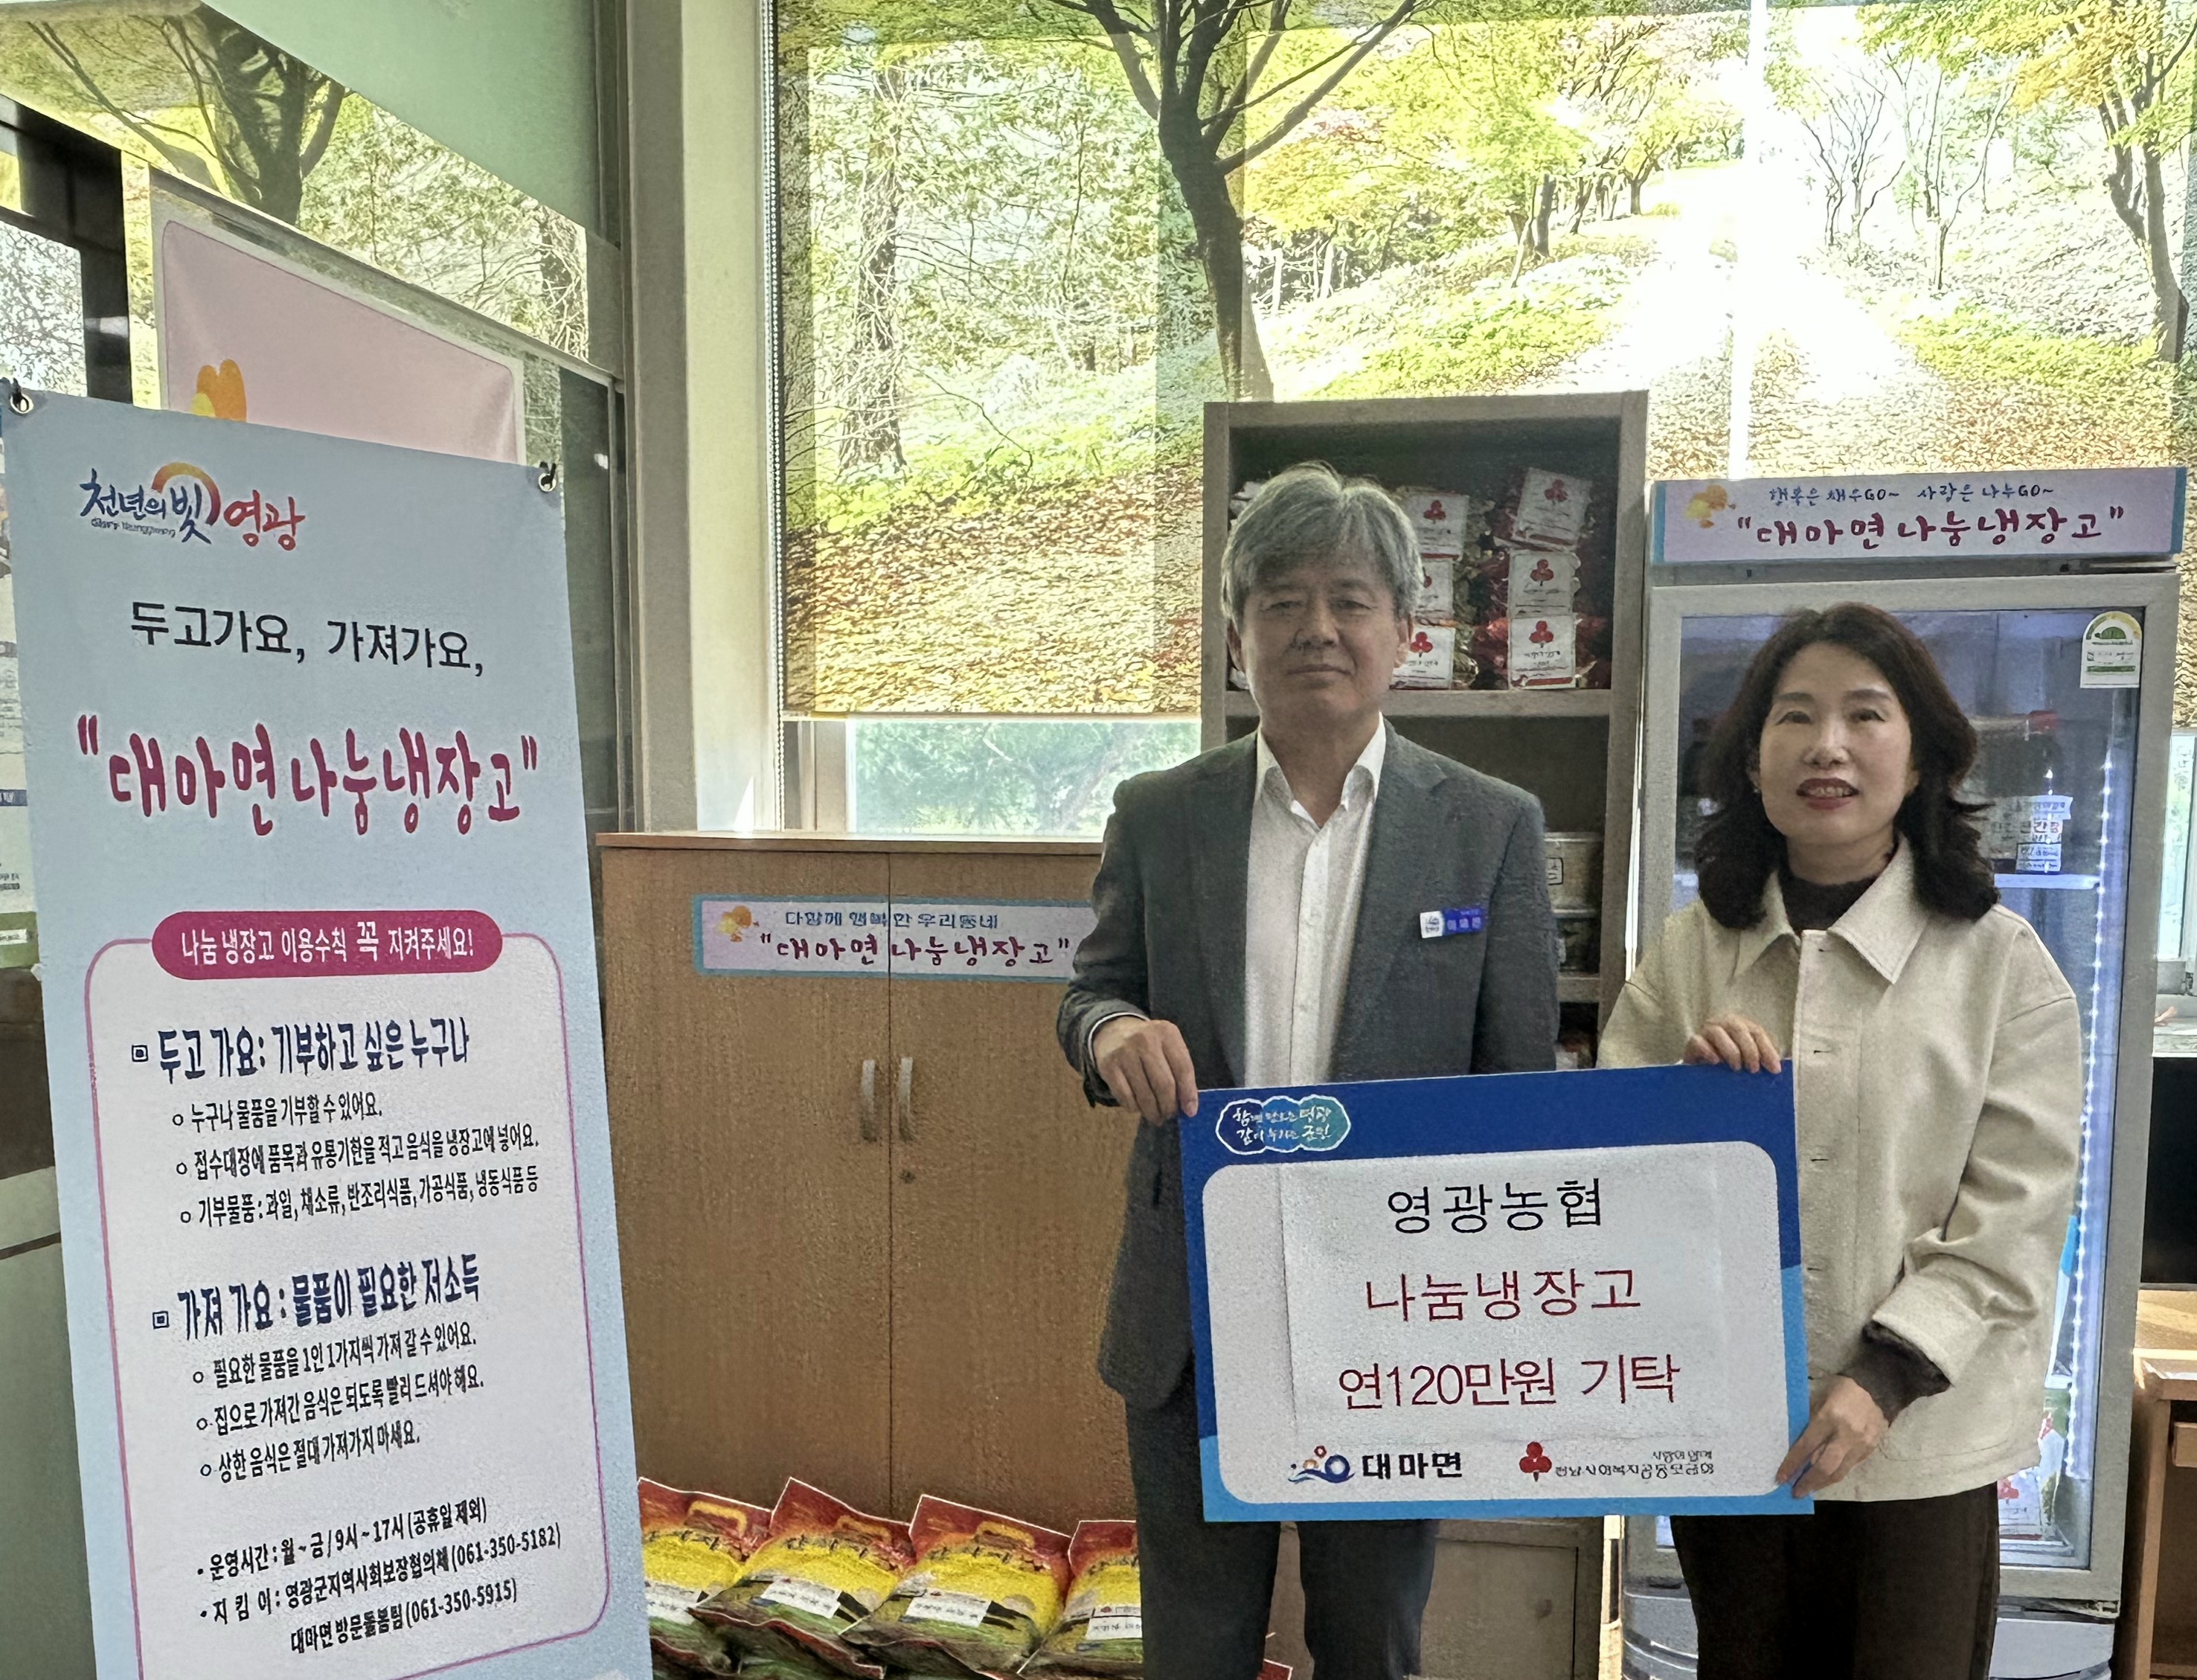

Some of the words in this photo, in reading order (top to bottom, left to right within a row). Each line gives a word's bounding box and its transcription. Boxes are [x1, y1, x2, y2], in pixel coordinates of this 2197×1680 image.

[224, 489, 306, 551] 영광
[1917, 484, 1974, 502] 사랑은
[131, 601, 305, 663] 두고가요,
[328, 621, 484, 677] 가져가요,
[281, 926, 347, 963] 이용수칙
[356, 920, 379, 961] 꼭
[388, 926, 474, 961] 지켜주세요!
[271, 1022, 358, 1076] 기부하고
[365, 1019, 403, 1071] 싶은
[410, 1016, 469, 1068] 누구나
[191, 1100, 234, 1132] 누구나
[237, 1097, 278, 1129] 물품을
[323, 1094, 336, 1123] 수
[339, 1091, 382, 1121] 있어요.
[194, 1144, 266, 1180] 접수대장에
[378, 1135, 404, 1163] 적고
[406, 1130, 444, 1160] 음식을
[446, 1125, 495, 1156] 냉장고에
[1388, 1177, 1602, 1234] 영광농협
[292, 1269, 352, 1327] 물품이
[357, 1261, 417, 1318] 필요한
[421, 1253, 479, 1304] 저소득
[1366, 1269, 1641, 1322] 나눔냉장고
[214, 1352, 255, 1388] 필요한
[259, 1347, 299, 1382] 물품을
[1338, 1359, 1556, 1411] 연120만원
[1581, 1353, 1681, 1405] 기탁
[214, 1402, 259, 1436] 집으로
[304, 1386, 344, 1421] 음식은
[345, 1379, 384, 1413] 되도록
[219, 1449, 247, 1483] 상한
[250, 1442, 291, 1478] 음식은
[1362, 1452, 1463, 1480] 대마면
[291, 1620, 333, 1653] 대마면
